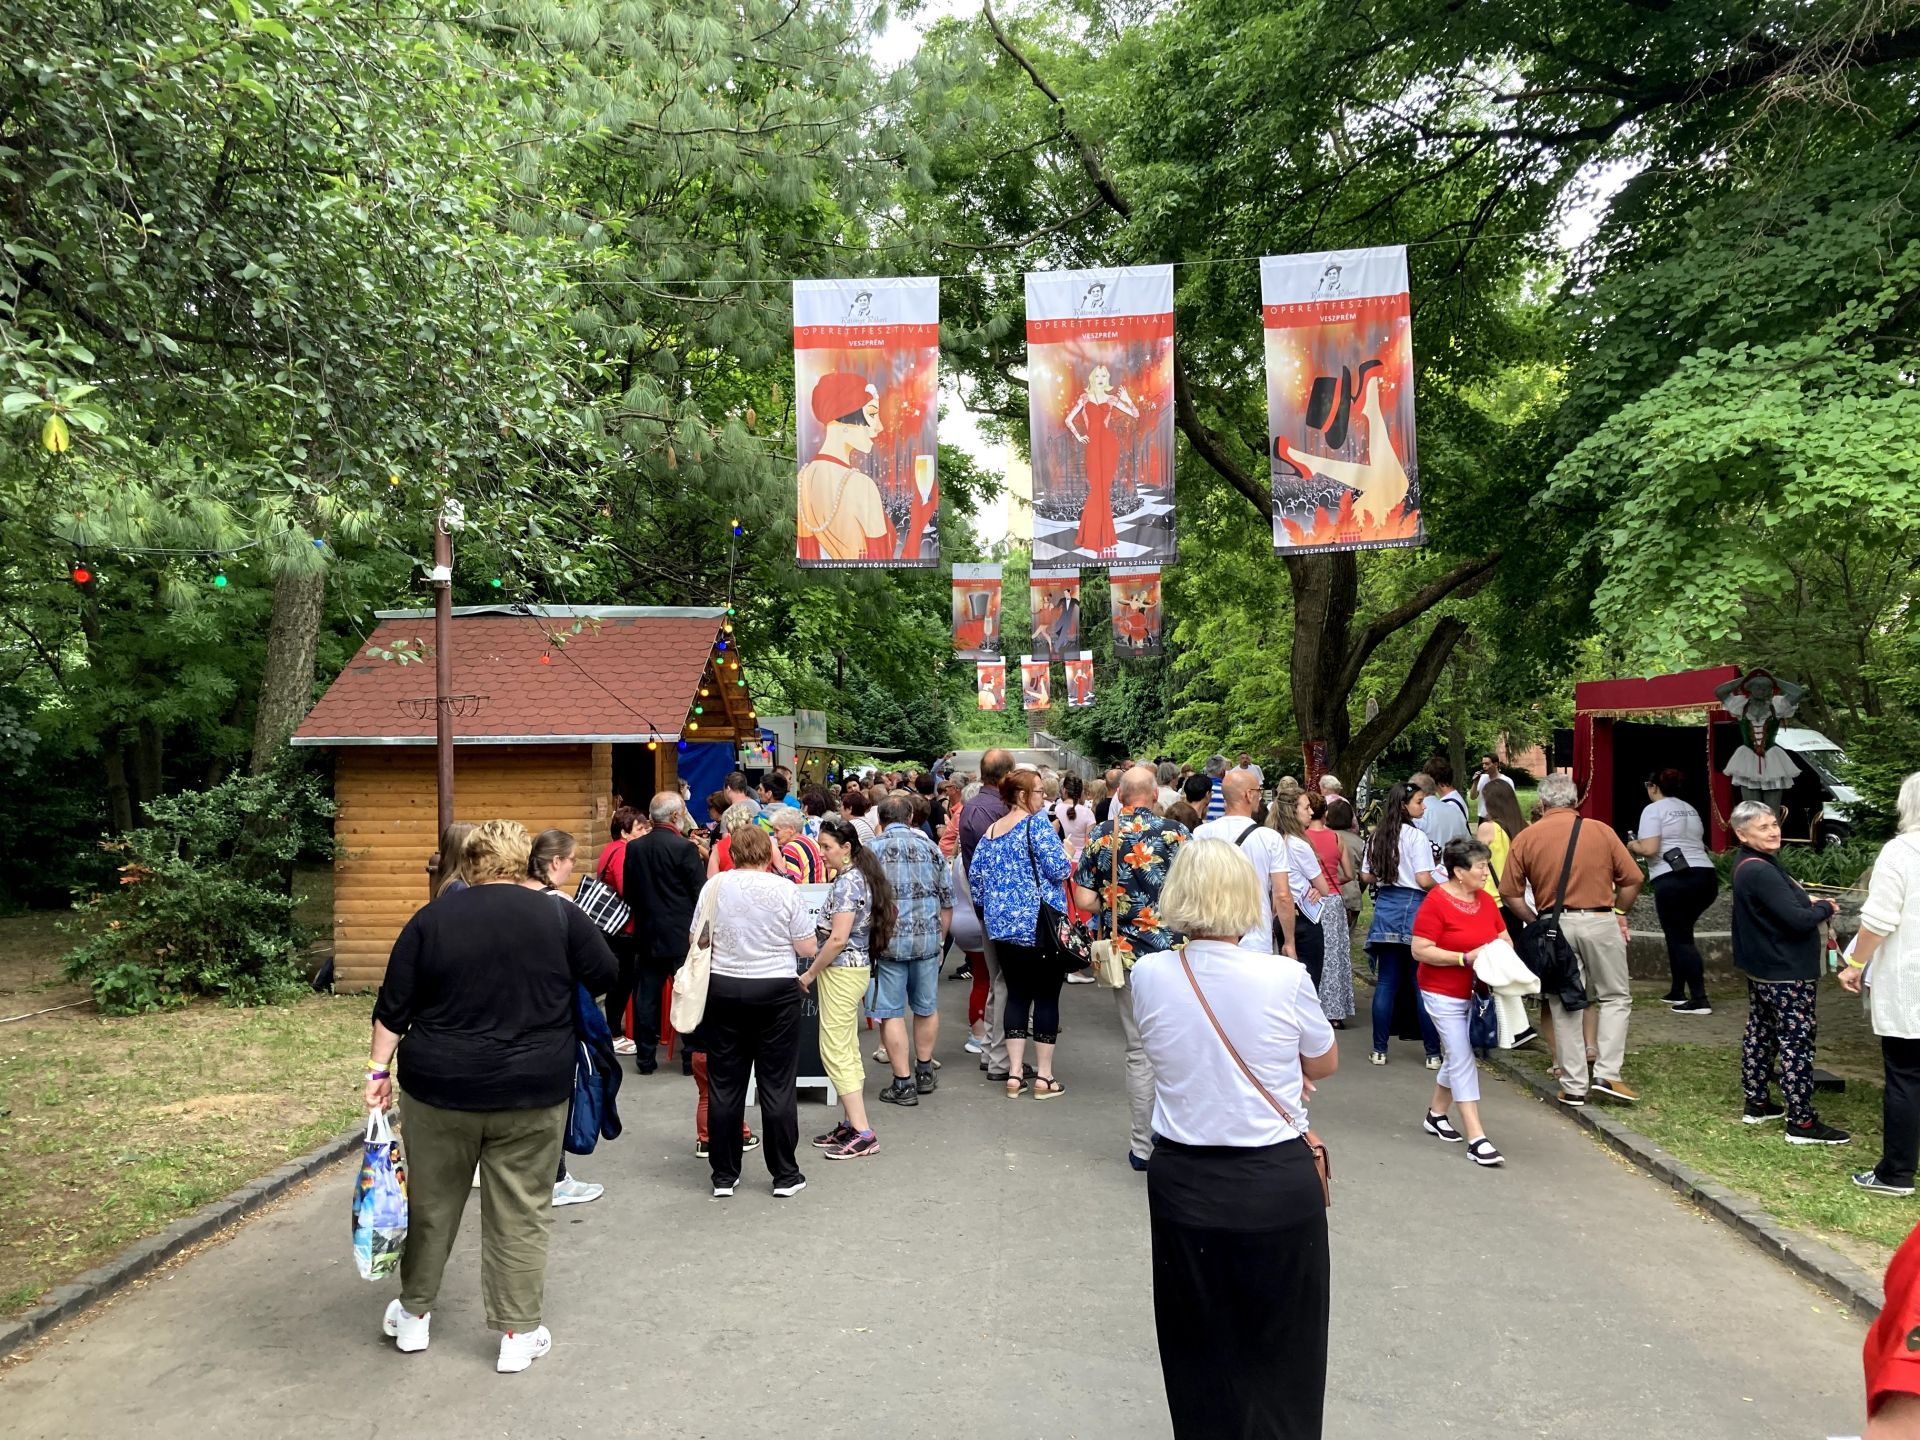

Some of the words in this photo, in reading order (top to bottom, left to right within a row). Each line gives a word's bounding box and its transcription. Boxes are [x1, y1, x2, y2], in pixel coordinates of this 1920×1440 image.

[1319, 313, 1357, 322] VESZPRÉM
[1034, 316, 1165, 330] OPERETTFESZTIVÁL
[802, 325, 931, 336] OPERETTFESZTIVÁL
[1081, 331, 1119, 340] VESZPRÉM
[848, 338, 885, 347] VESZPRÉM
[1293, 547, 1339, 555] VESZPRÉMI
[1341, 544, 1371, 552] PETŐFI
[1373, 541, 1410, 550] SZÍNHÁZ
[1128, 558, 1164, 566] SZÍNHÁZ
